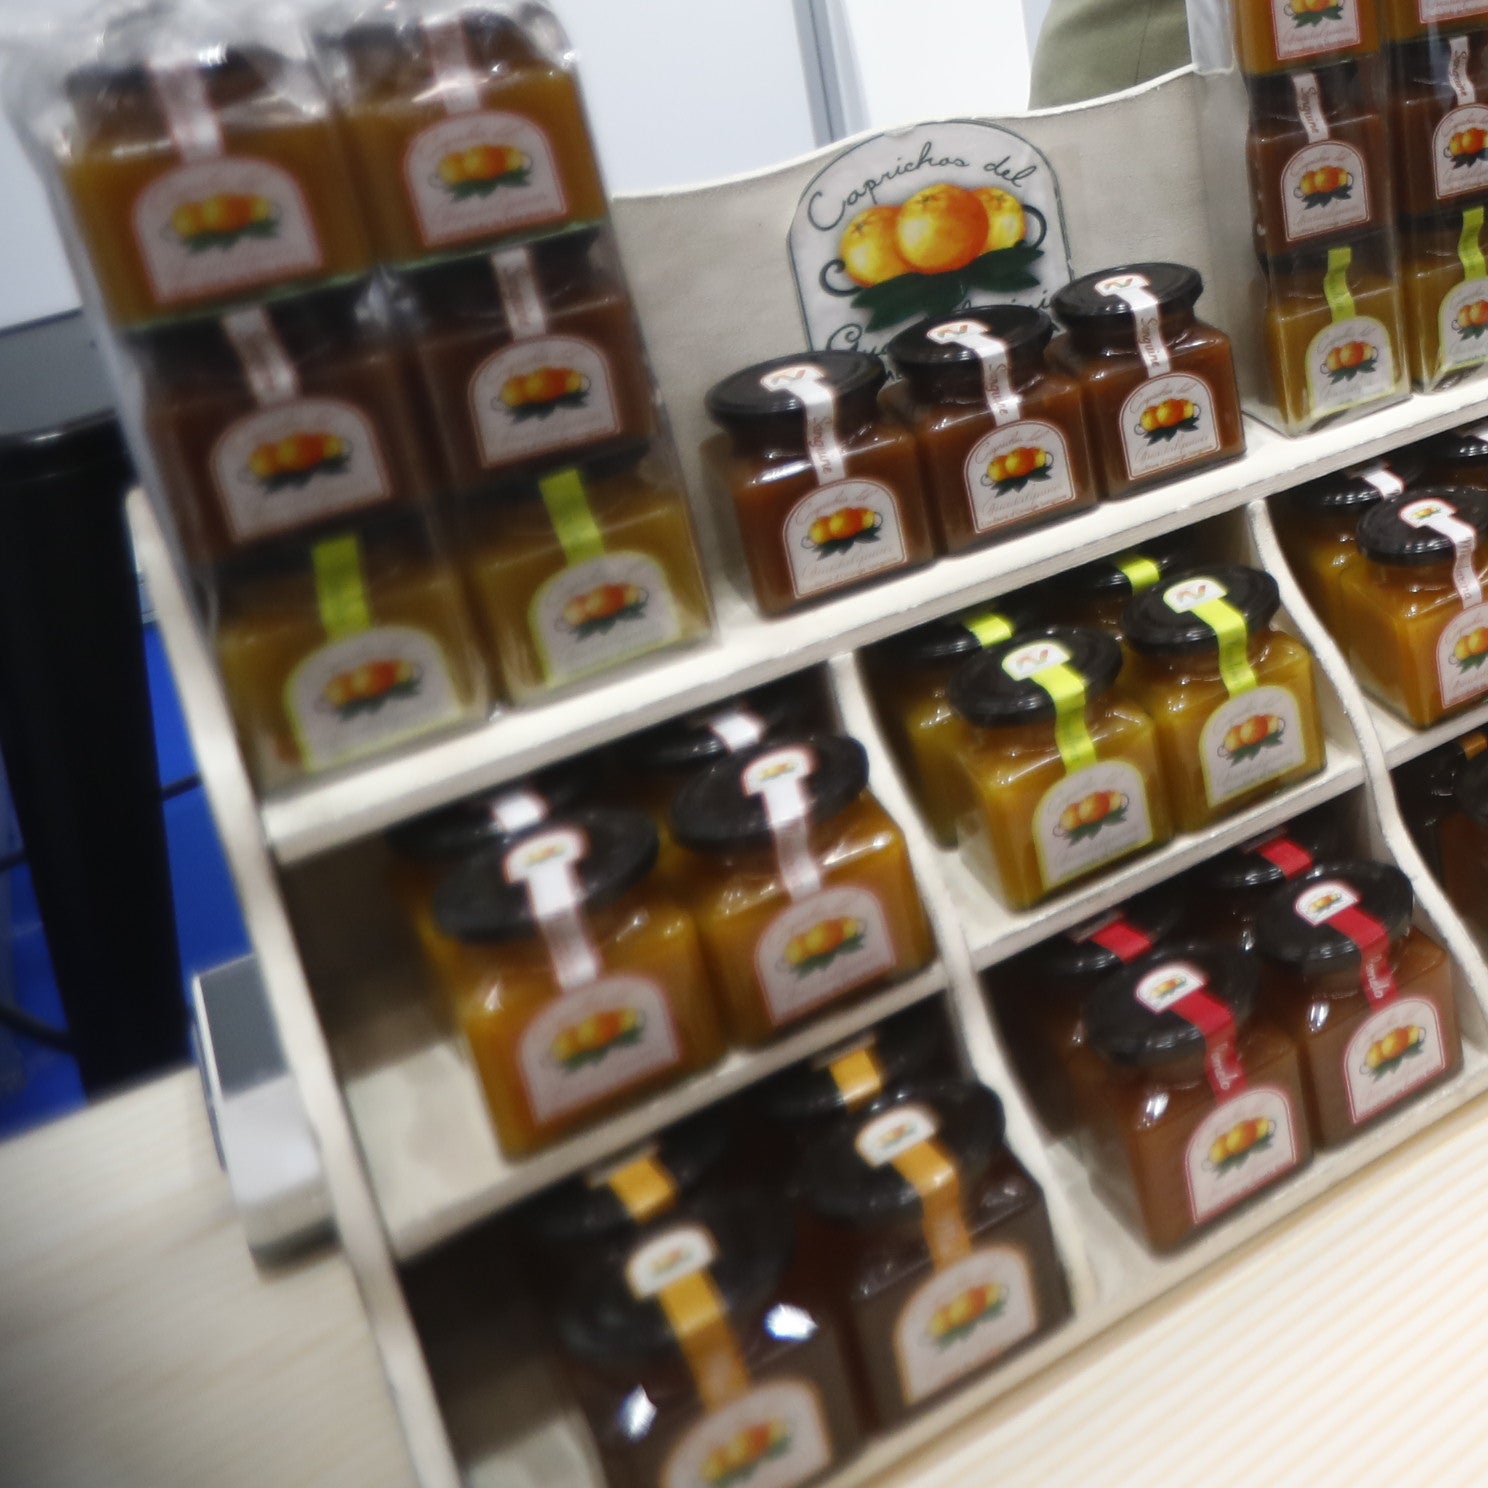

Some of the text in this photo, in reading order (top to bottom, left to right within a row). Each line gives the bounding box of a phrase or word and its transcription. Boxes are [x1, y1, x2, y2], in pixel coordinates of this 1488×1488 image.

[807, 141, 1038, 232] Caprichos del
[1140, 318, 1161, 368] Sanguine
